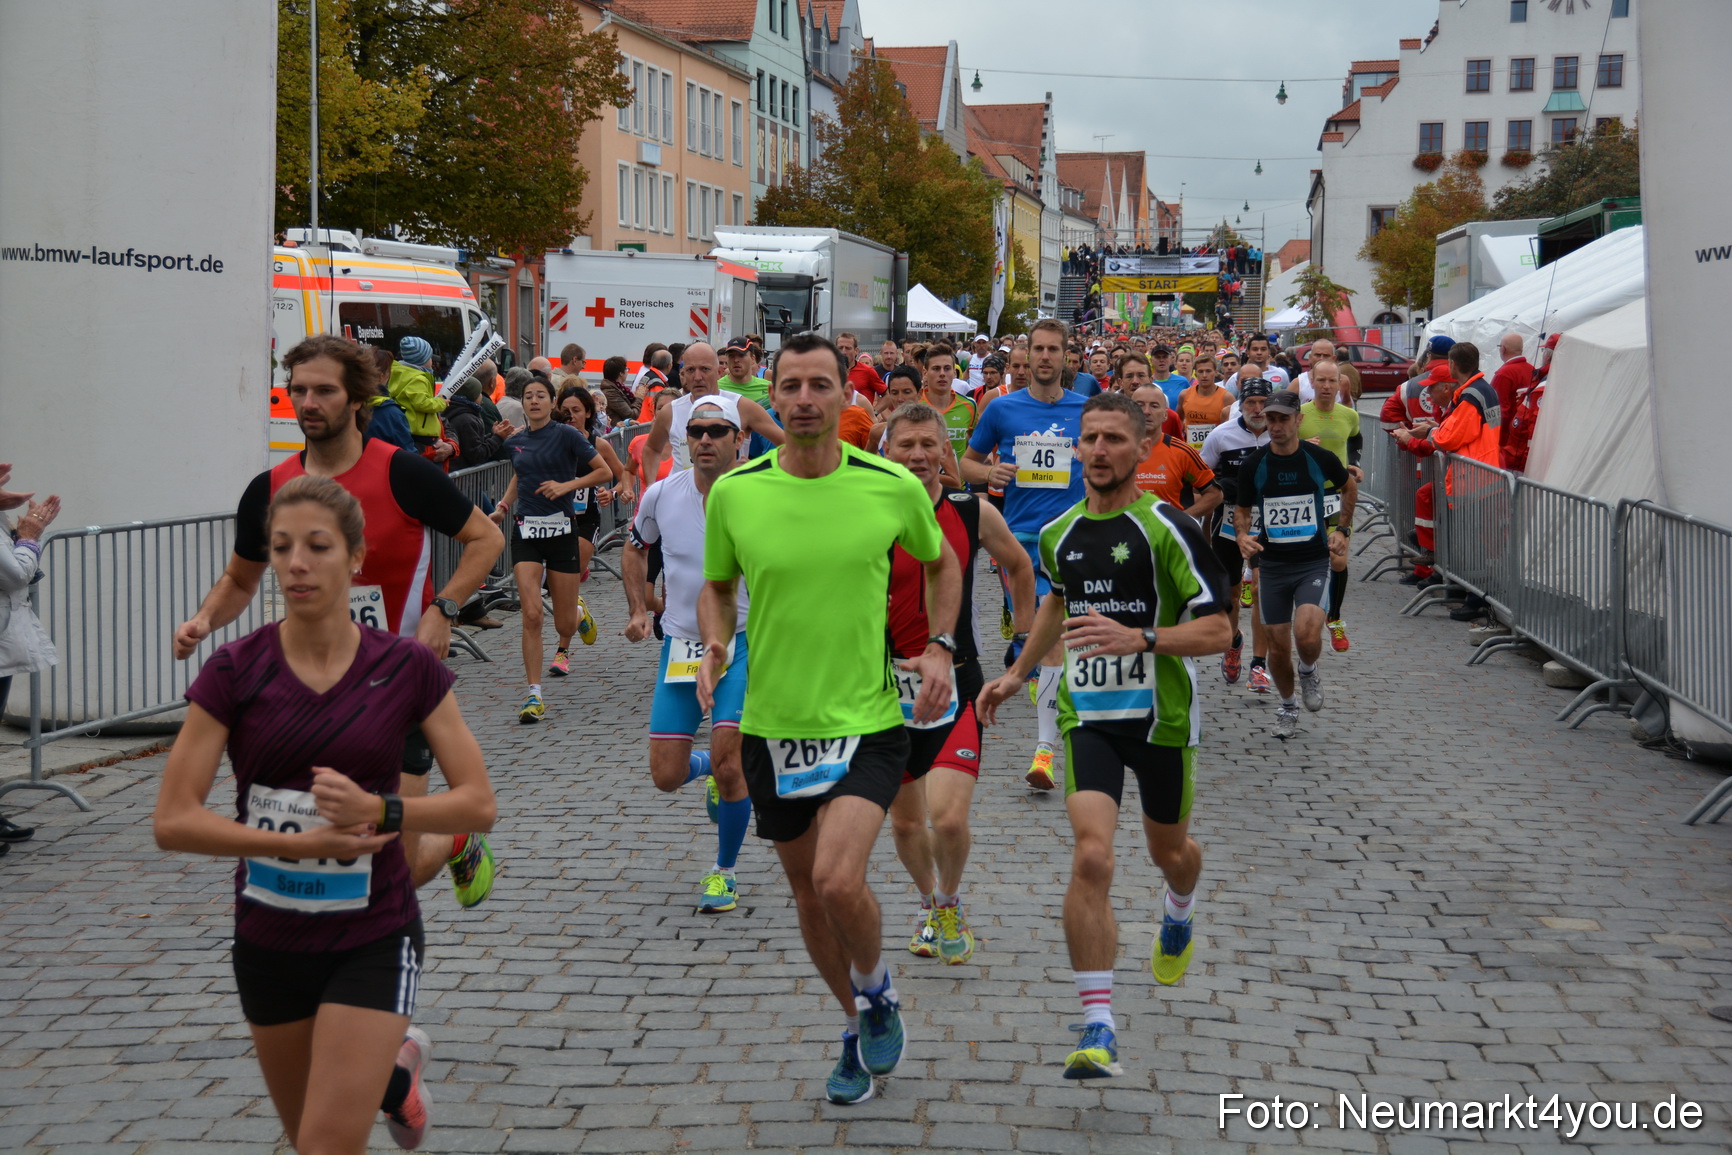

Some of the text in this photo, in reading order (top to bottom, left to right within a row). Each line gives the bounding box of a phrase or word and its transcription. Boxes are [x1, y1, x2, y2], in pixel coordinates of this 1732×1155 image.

[2, 243, 224, 273] www.bmw-laufsport.de
[1139, 280, 1179, 290] START
[620, 298, 674, 308] Bayerisches
[620, 310, 645, 318] Rotes
[357, 325, 384, 341] Bayerisches
[619, 321, 645, 329] Kreuz
[911, 321, 947, 330] Laufsport
[446, 340, 501, 395] bmw-laufsport.de
[1032, 449, 1055, 468] 46
[1032, 473, 1053, 481] Mario
[1269, 506, 1312, 526] 2374
[1084, 579, 1113, 594] DAV
[1069, 598, 1146, 614] Röthenbach
[1074, 652, 1147, 687] 3014
[251, 796, 285, 813] PARTL
[277, 873, 326, 895] Sarah
